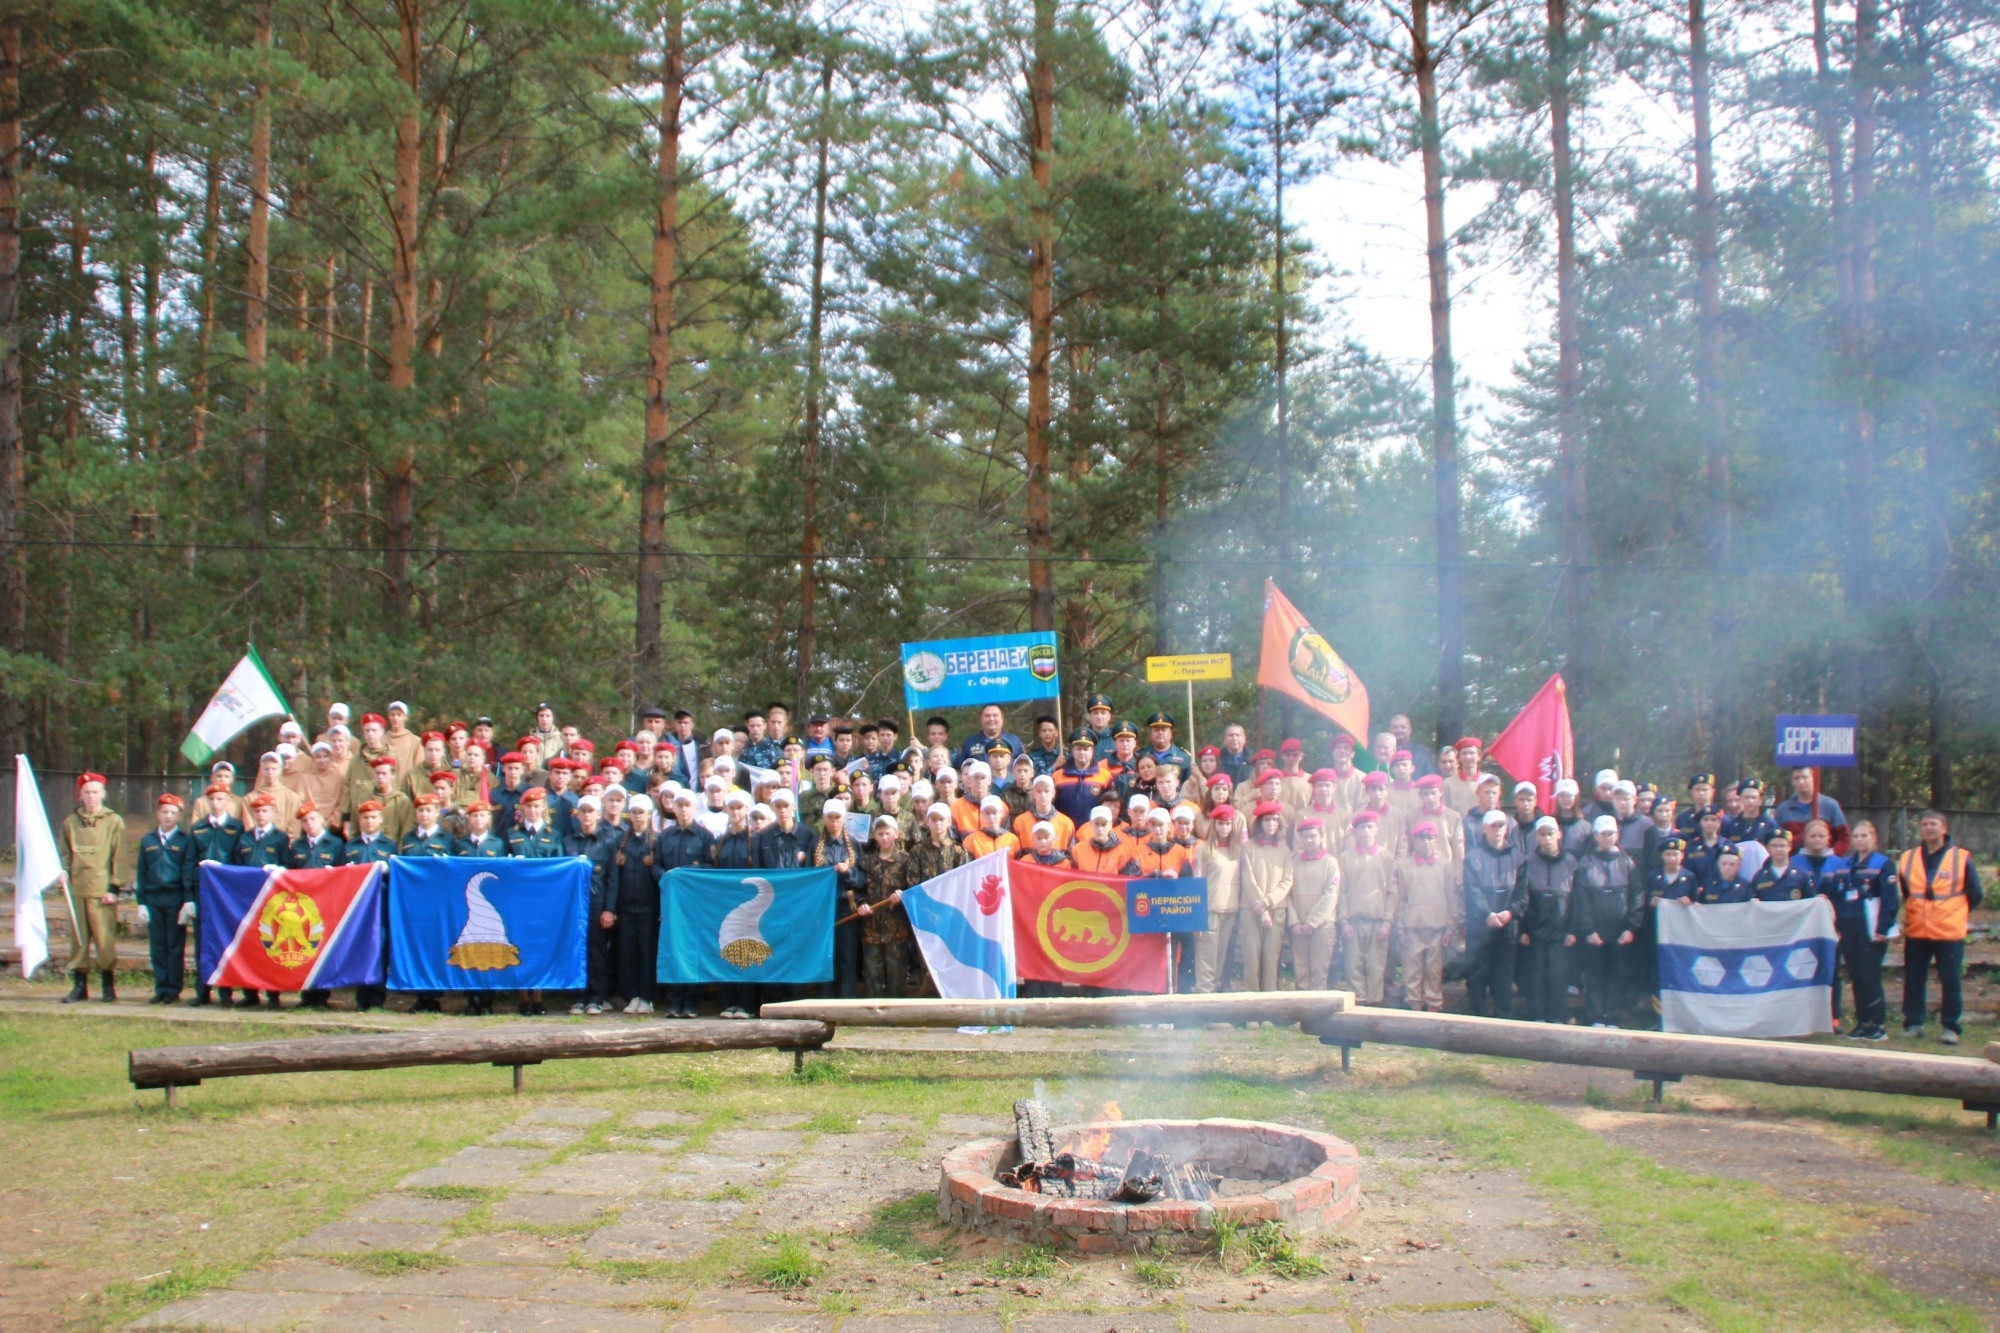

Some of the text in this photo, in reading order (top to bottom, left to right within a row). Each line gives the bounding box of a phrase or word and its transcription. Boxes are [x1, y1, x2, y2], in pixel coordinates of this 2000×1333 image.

[945, 647, 1028, 674] БЕРЕНДЕЙ
[980, 676, 1009, 686] Очер
[1151, 895, 1201, 905] ПЕРМСКИЙ
[1161, 905, 1192, 914] РАЙОН
[279, 953, 304, 961] ВДПО
